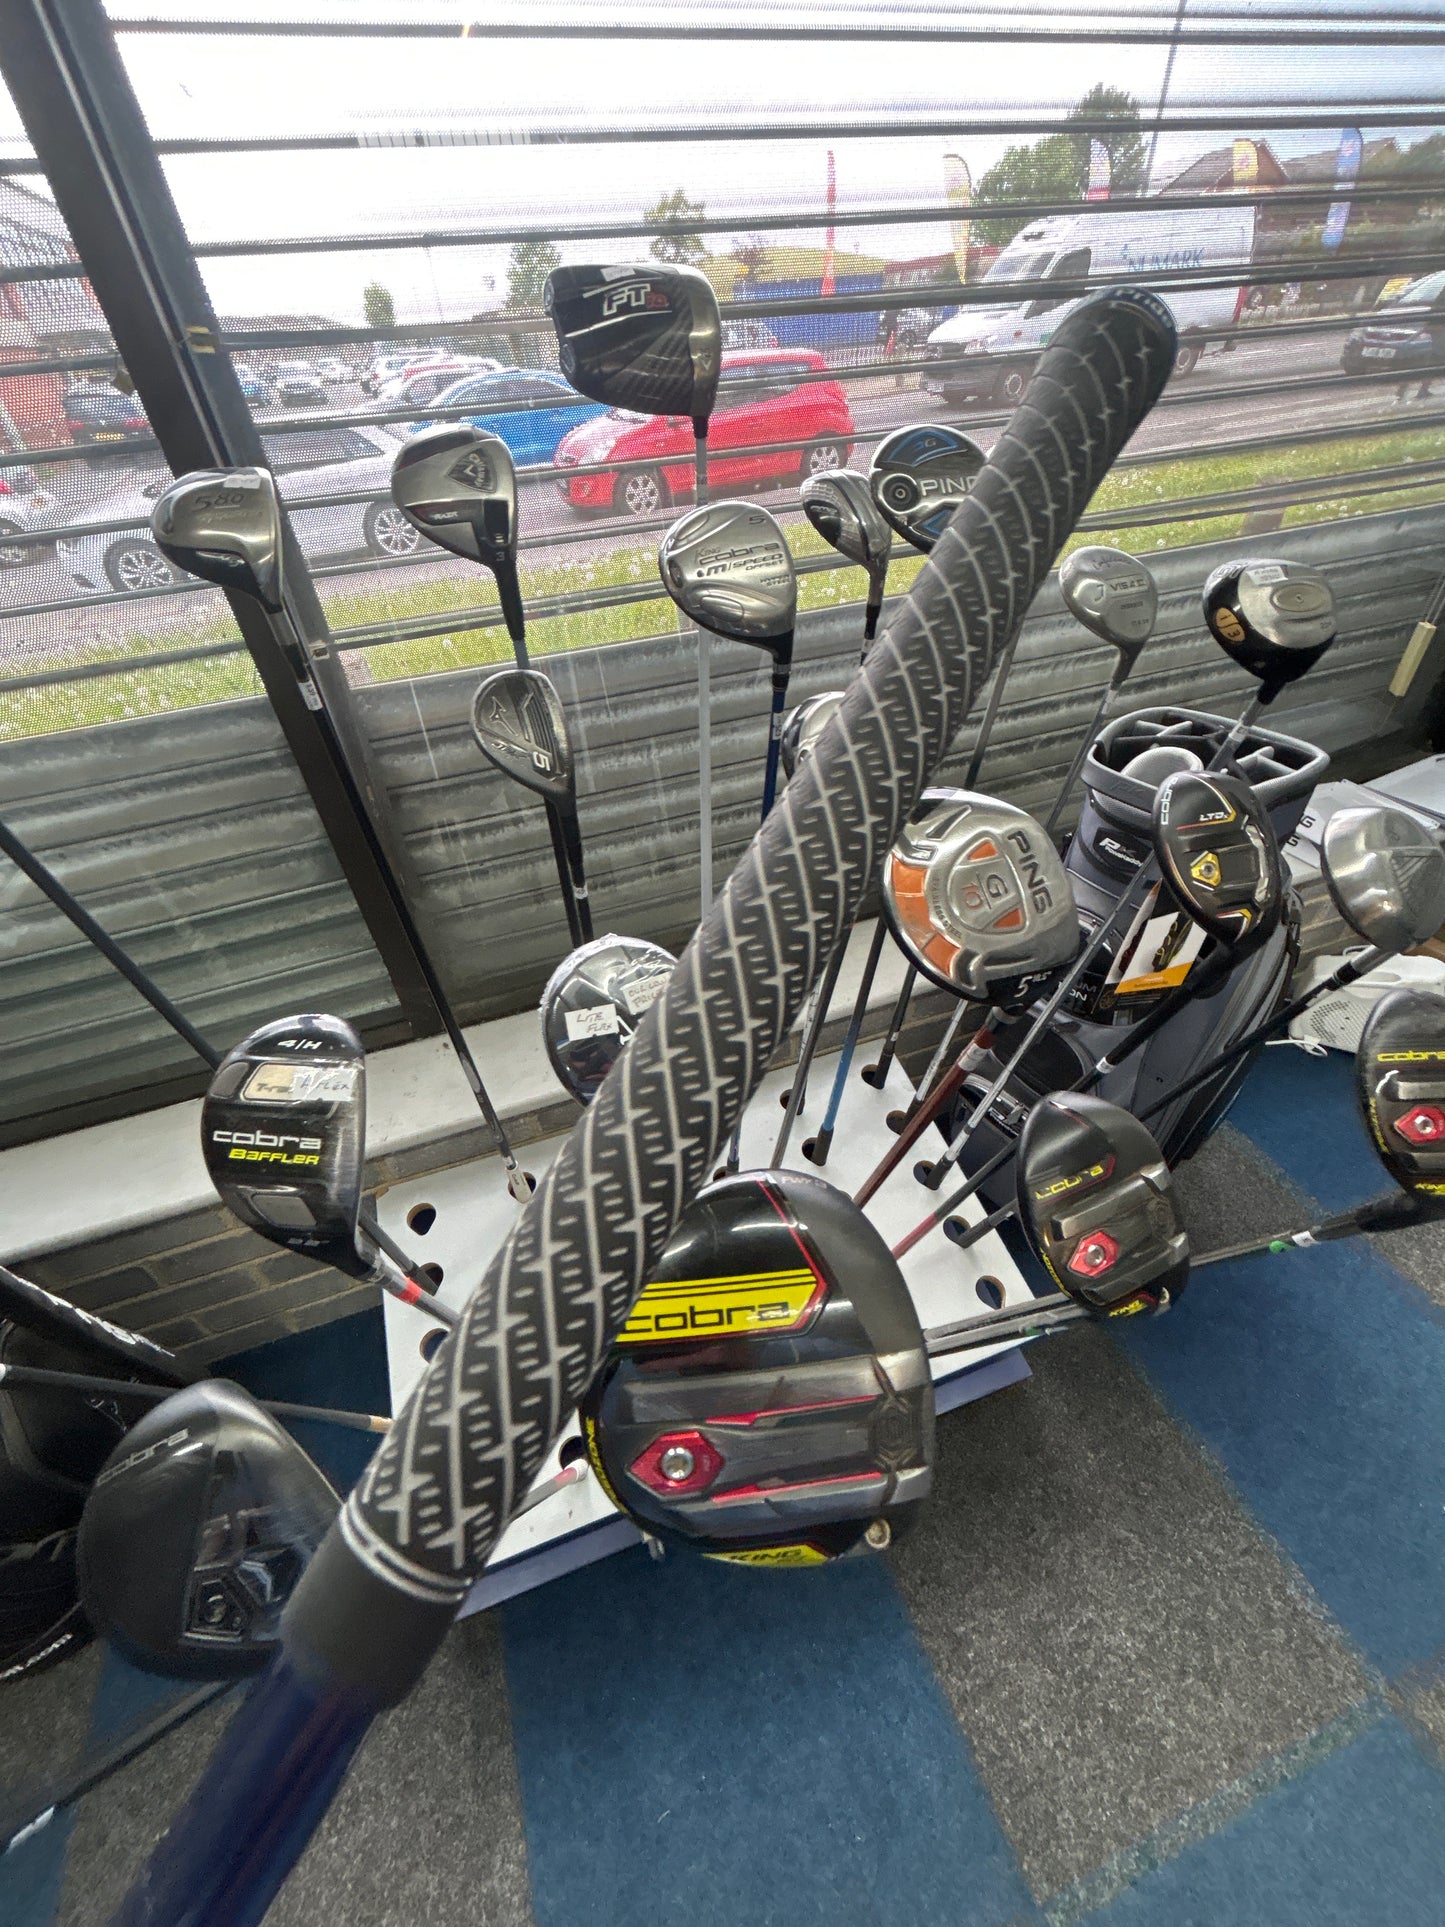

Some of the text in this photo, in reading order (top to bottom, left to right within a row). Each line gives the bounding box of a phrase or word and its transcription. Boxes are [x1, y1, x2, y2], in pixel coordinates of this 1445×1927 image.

[920, 475, 977, 497] PIN
[749, 514, 766, 525] 5
[699, 542, 780, 566] cobra
[1007, 829, 1054, 915] PING
[986, 873, 1008, 899] G
[212, 1129, 323, 1150] cobra
[623, 1301, 790, 1335] cobra
